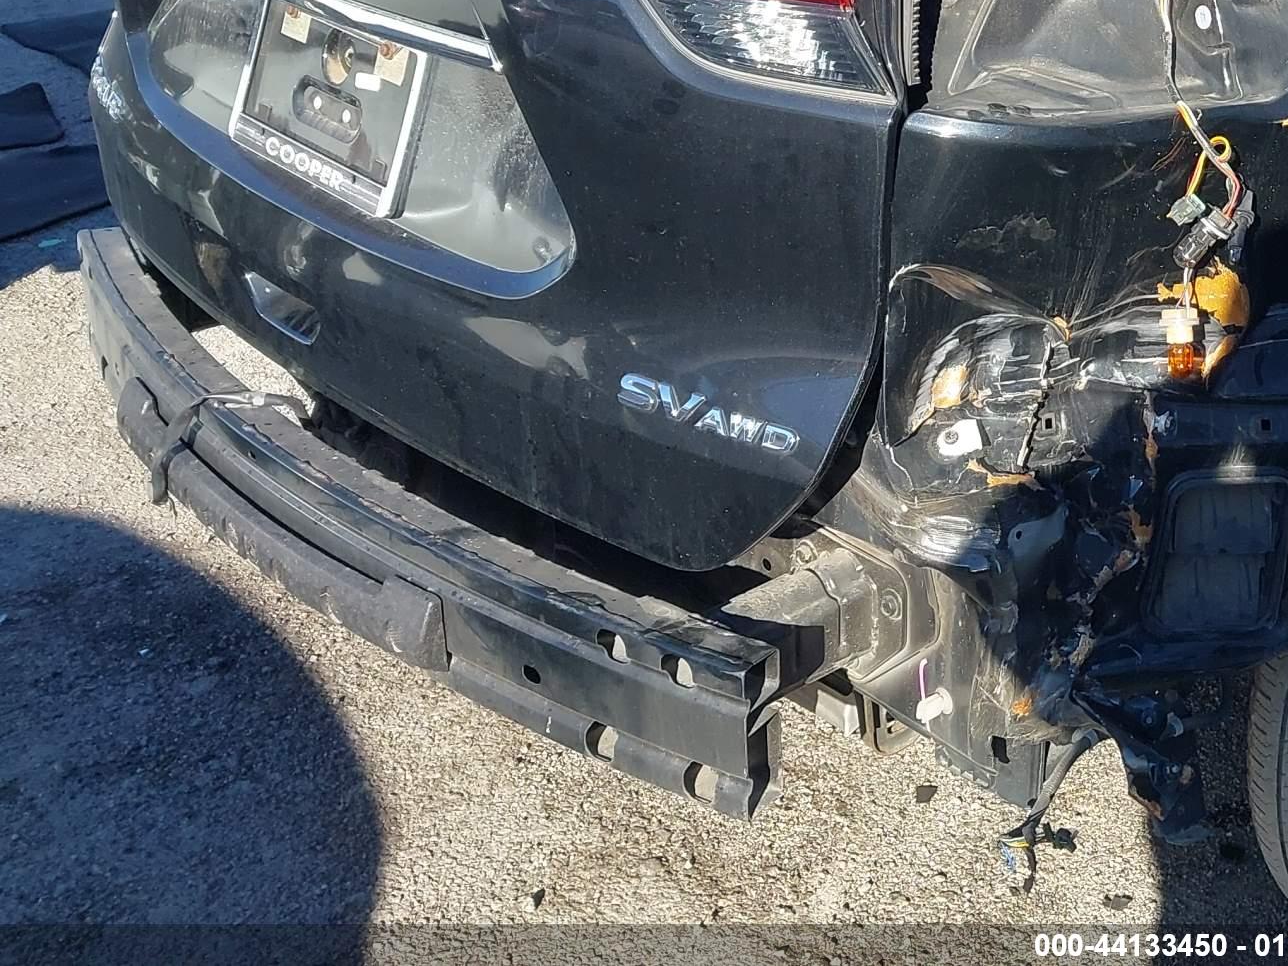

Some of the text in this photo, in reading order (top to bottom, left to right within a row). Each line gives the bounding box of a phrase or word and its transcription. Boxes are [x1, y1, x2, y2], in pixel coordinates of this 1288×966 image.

[265, 136, 344, 191] COOPER
[617, 372, 800, 456] SV AWD
